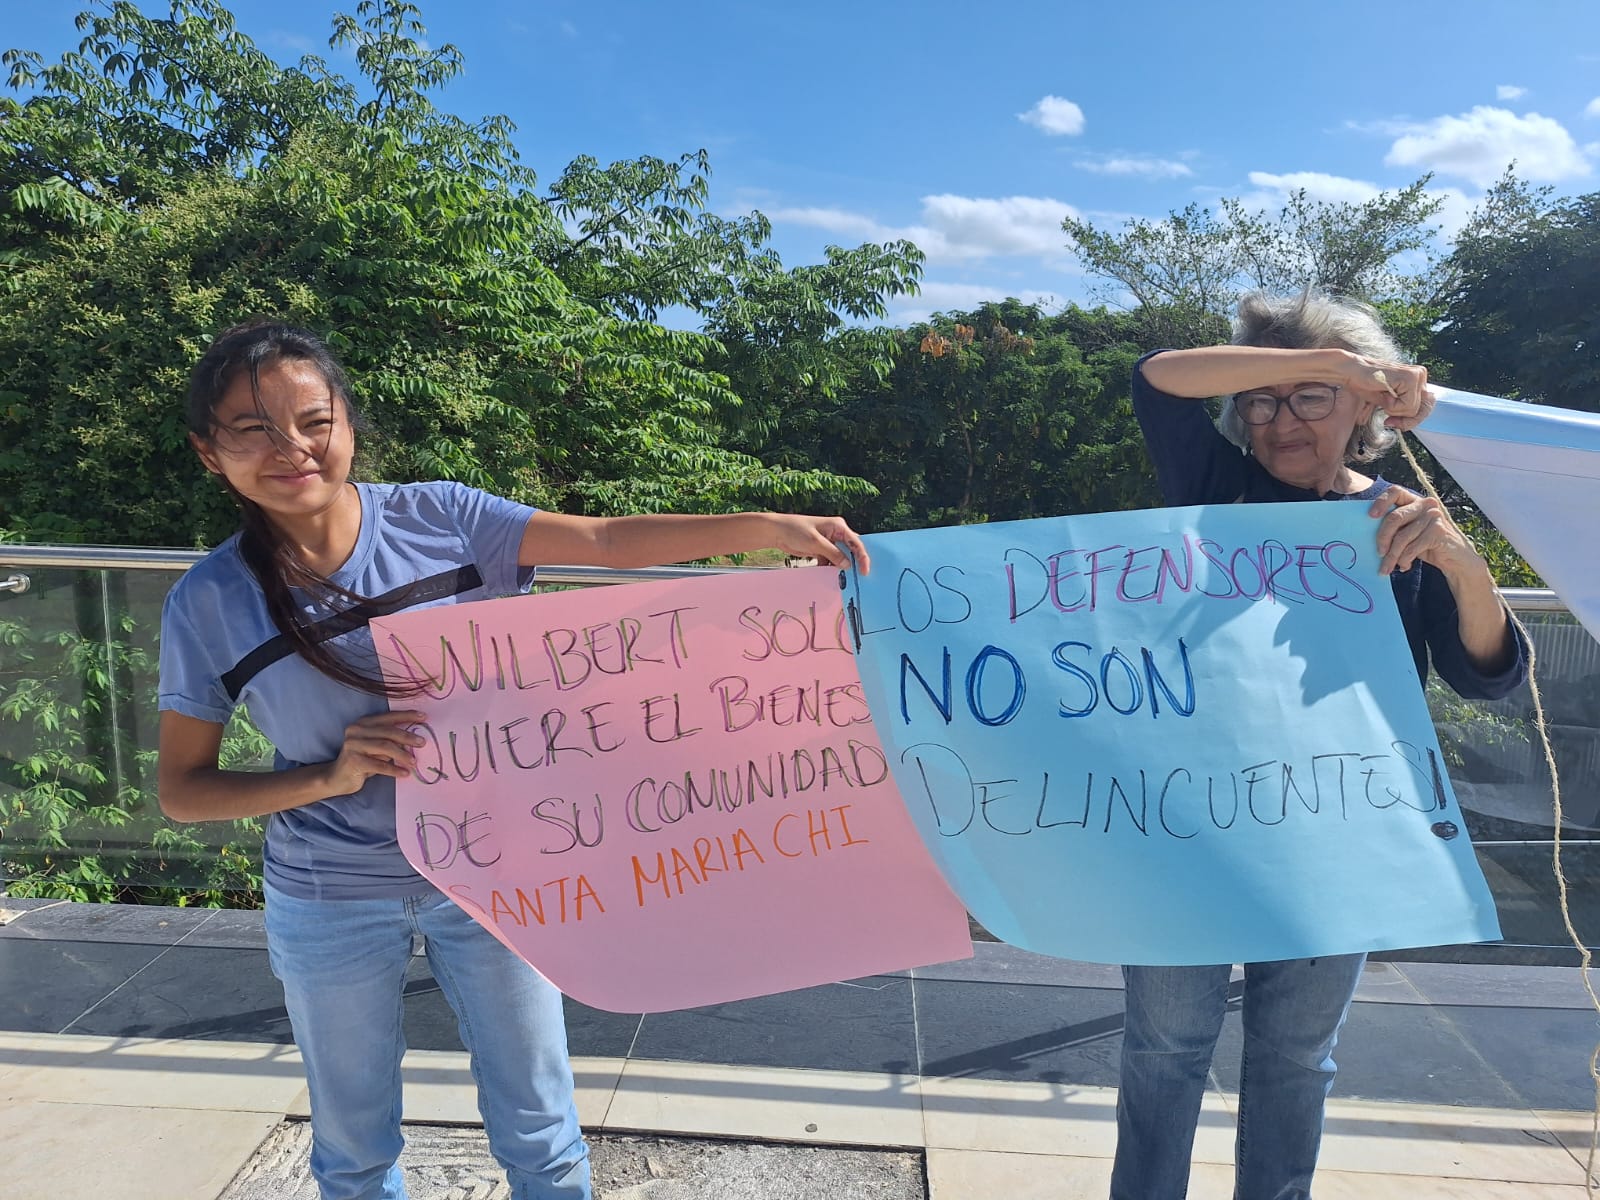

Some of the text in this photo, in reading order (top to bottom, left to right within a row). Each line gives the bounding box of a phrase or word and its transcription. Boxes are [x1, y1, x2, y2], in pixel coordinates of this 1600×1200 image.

[1003, 533, 1375, 624] DEFENSORES
[389, 606, 699, 700] WILBERT
[900, 636, 1196, 727] NO SON
[405, 701, 626, 784] QUIERE
[639, 693, 703, 743] EL
[415, 739, 889, 871] DE SU COMUNIDAD
[901, 740, 1459, 841] DELINCUENTES!
[449, 804, 869, 928] SANTA MARIA CHI
